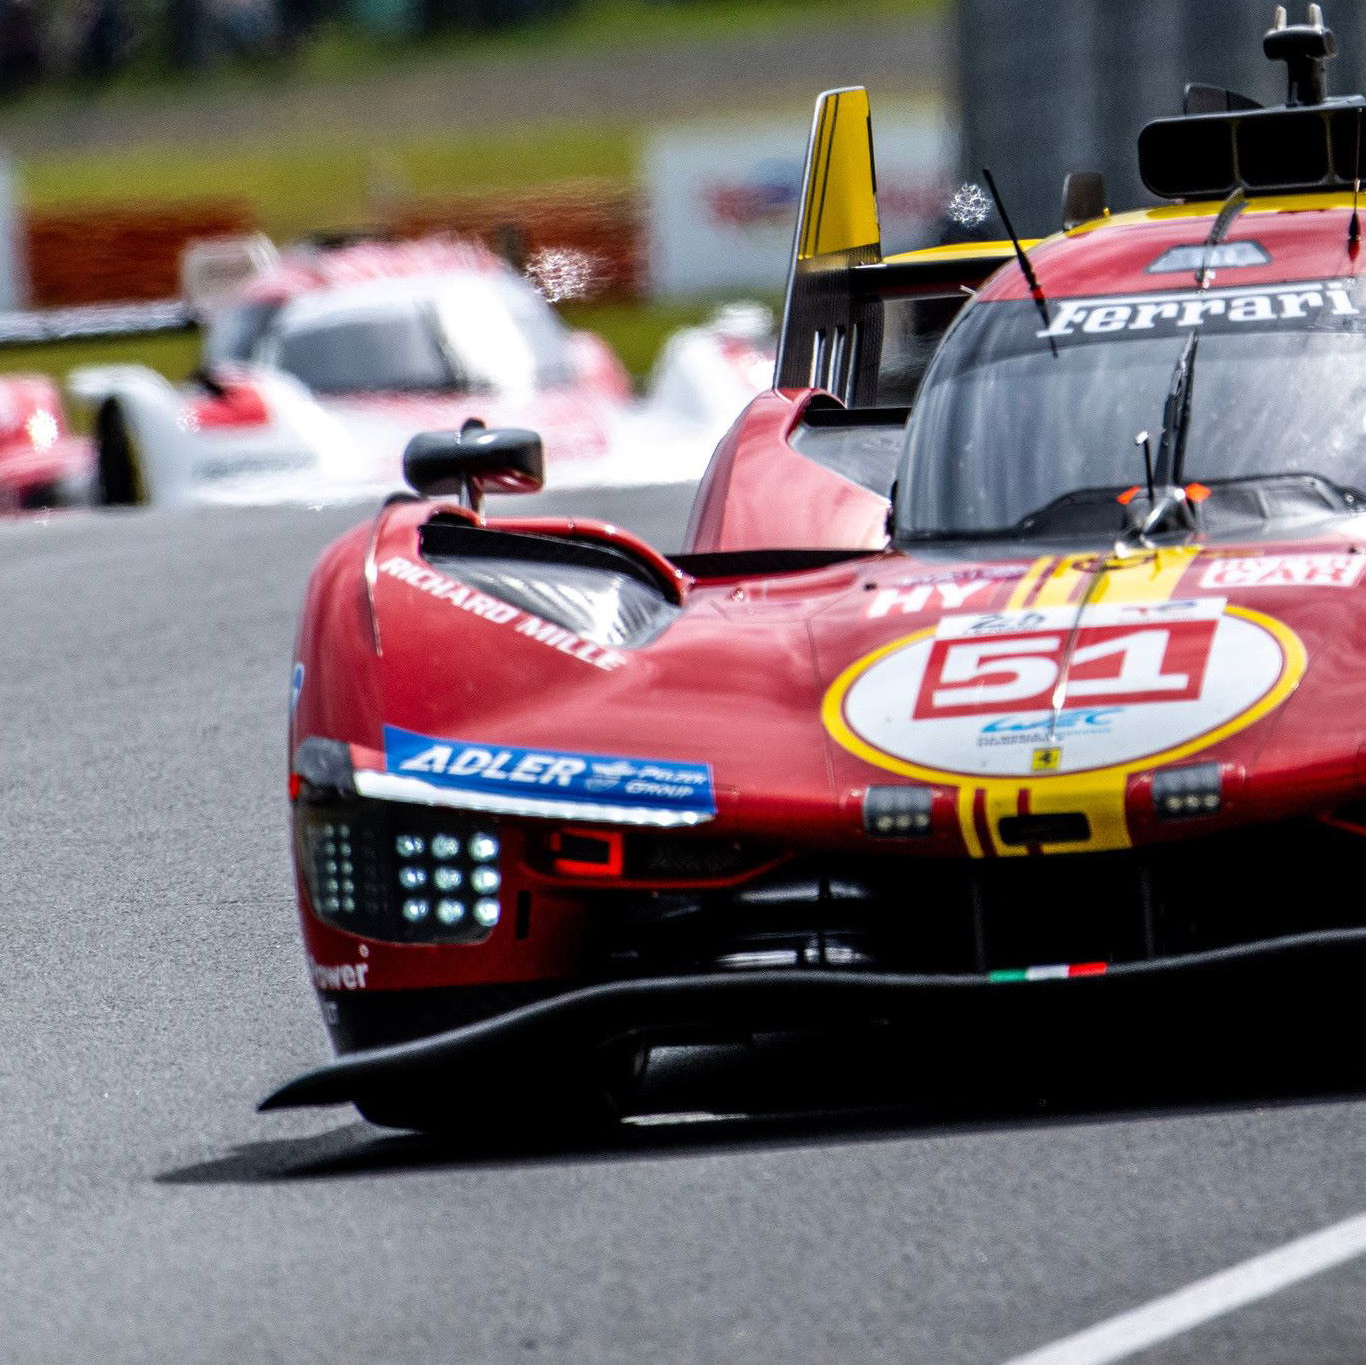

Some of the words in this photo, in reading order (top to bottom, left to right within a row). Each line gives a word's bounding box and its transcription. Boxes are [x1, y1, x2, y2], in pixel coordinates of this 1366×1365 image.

[1036, 279, 1360, 338] Ferrari
[378, 556, 523, 625] RICHARD
[514, 615, 628, 671] MILLE
[867, 578, 992, 618] HY
[931, 629, 1190, 708] 51
[400, 743, 588, 788] ADLER
